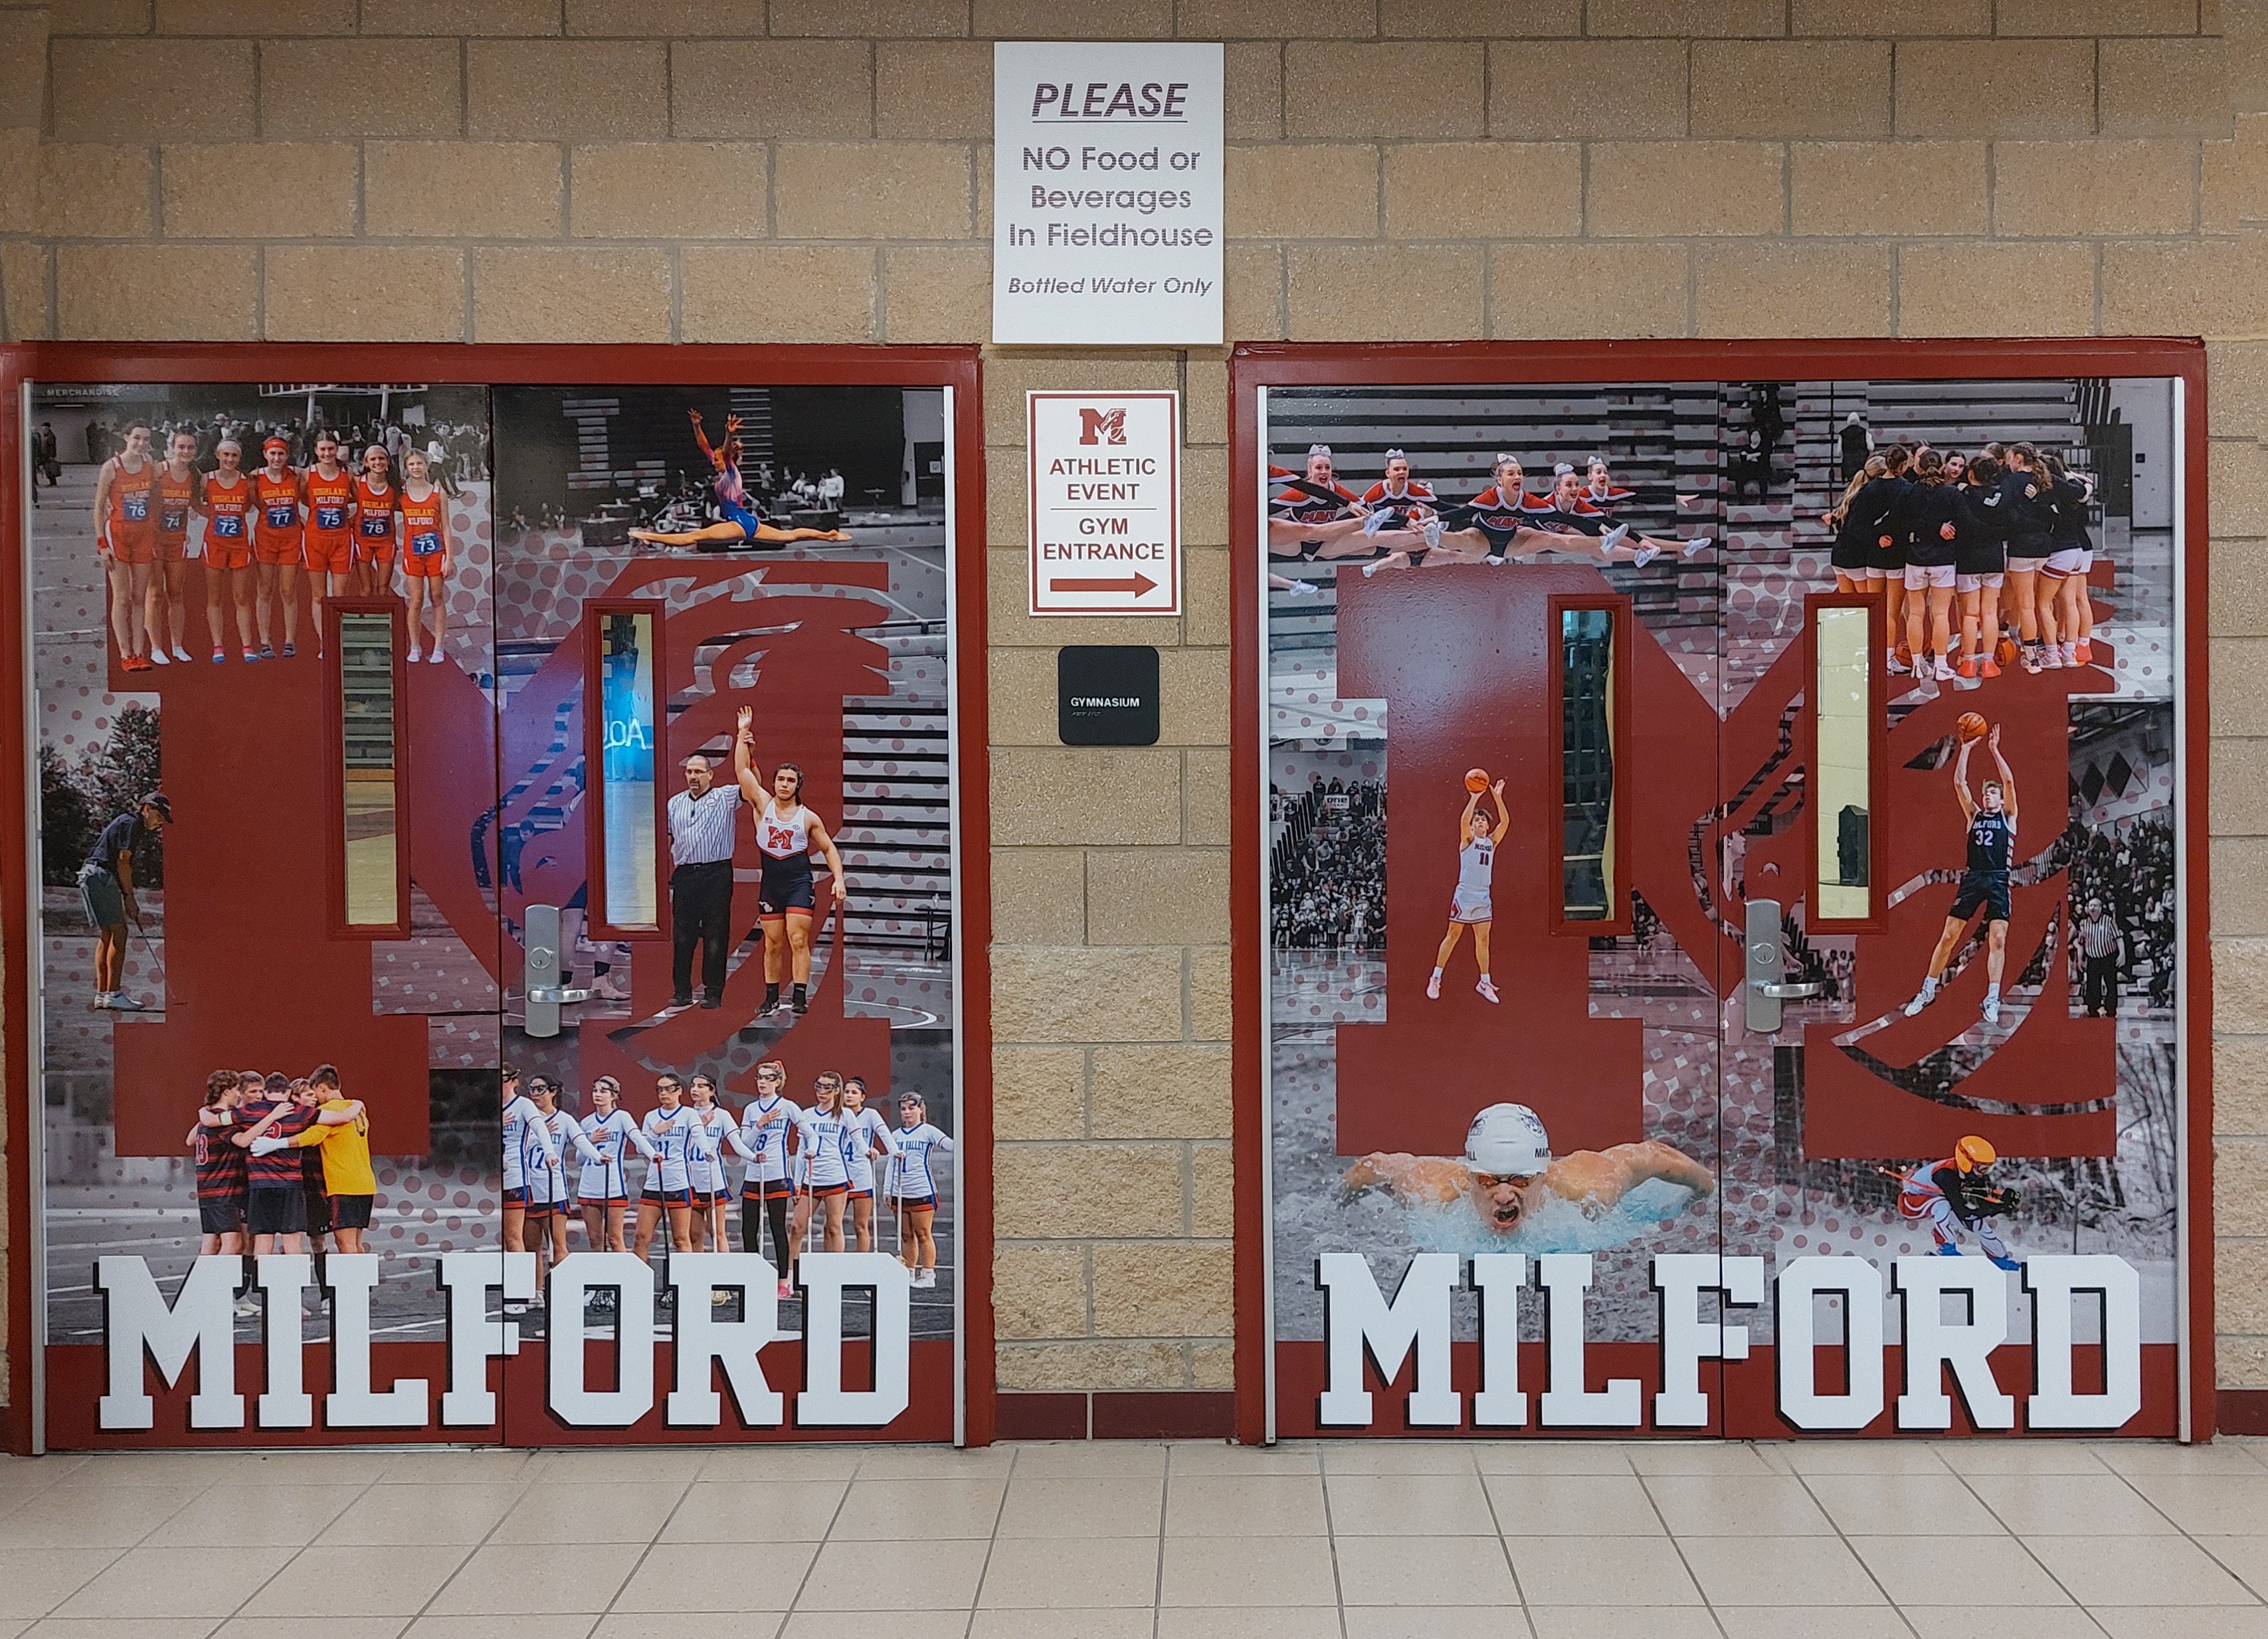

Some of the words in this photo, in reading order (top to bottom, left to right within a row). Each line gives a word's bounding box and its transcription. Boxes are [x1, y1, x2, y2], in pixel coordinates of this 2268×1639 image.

[1032, 83, 1188, 117] PLEASE
[1023, 147, 1070, 171] NO
[1082, 147, 1159, 171] Food
[1170, 151, 1200, 171] or
[1032, 185, 1192, 215] Beverages
[1010, 224, 1035, 246] In
[1048, 224, 1214, 246] Fieldhouse
[1008, 277, 1084, 294] Bottled
[1091, 278, 1157, 294] Water
[1164, 277, 1213, 297] Only
[1050, 458, 1156, 475] ATHLETIC
[1067, 484, 1140, 500] EVENT
[129, 506, 146, 517] 76
[272, 513, 290, 525] 77
[322, 514, 340, 526] 75
[219, 522, 237, 533] 72
[365, 524, 384, 534] 78
[1079, 518, 1128, 535] GYM
[417, 539, 436, 553] 73
[1043, 543, 1165, 560] ENTRANCE
[1070, 697, 1140, 708] GYMNASIUM
[1975, 830, 1994, 846] 32
[94, 1252, 910, 1430] MILFORD
[1316, 1252, 2141, 1431] MILFORD
